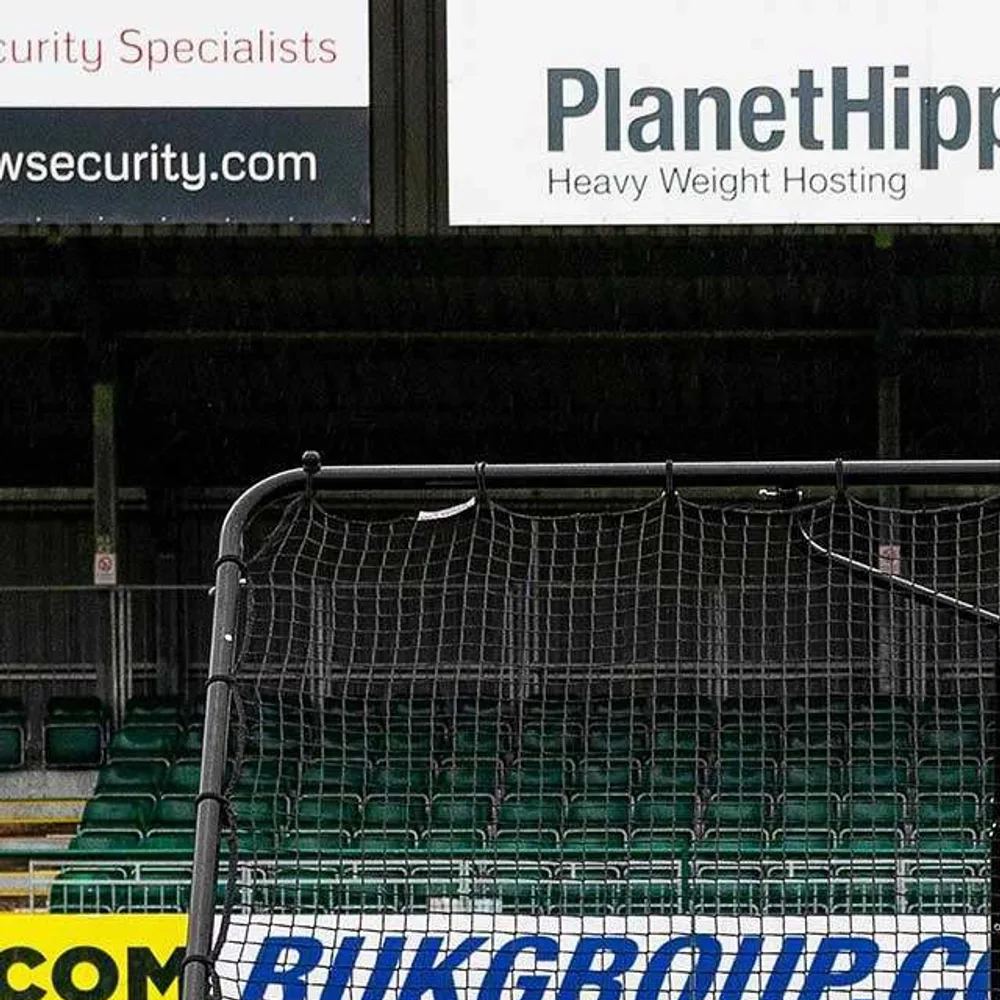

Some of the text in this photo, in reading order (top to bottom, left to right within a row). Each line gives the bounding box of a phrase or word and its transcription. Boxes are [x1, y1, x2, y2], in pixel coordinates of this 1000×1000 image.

[119, 28, 338, 72] Specialists
[0, 143, 317, 191] wsecurity.com
[548, 165, 906, 201] Heavy Weight Hosting
